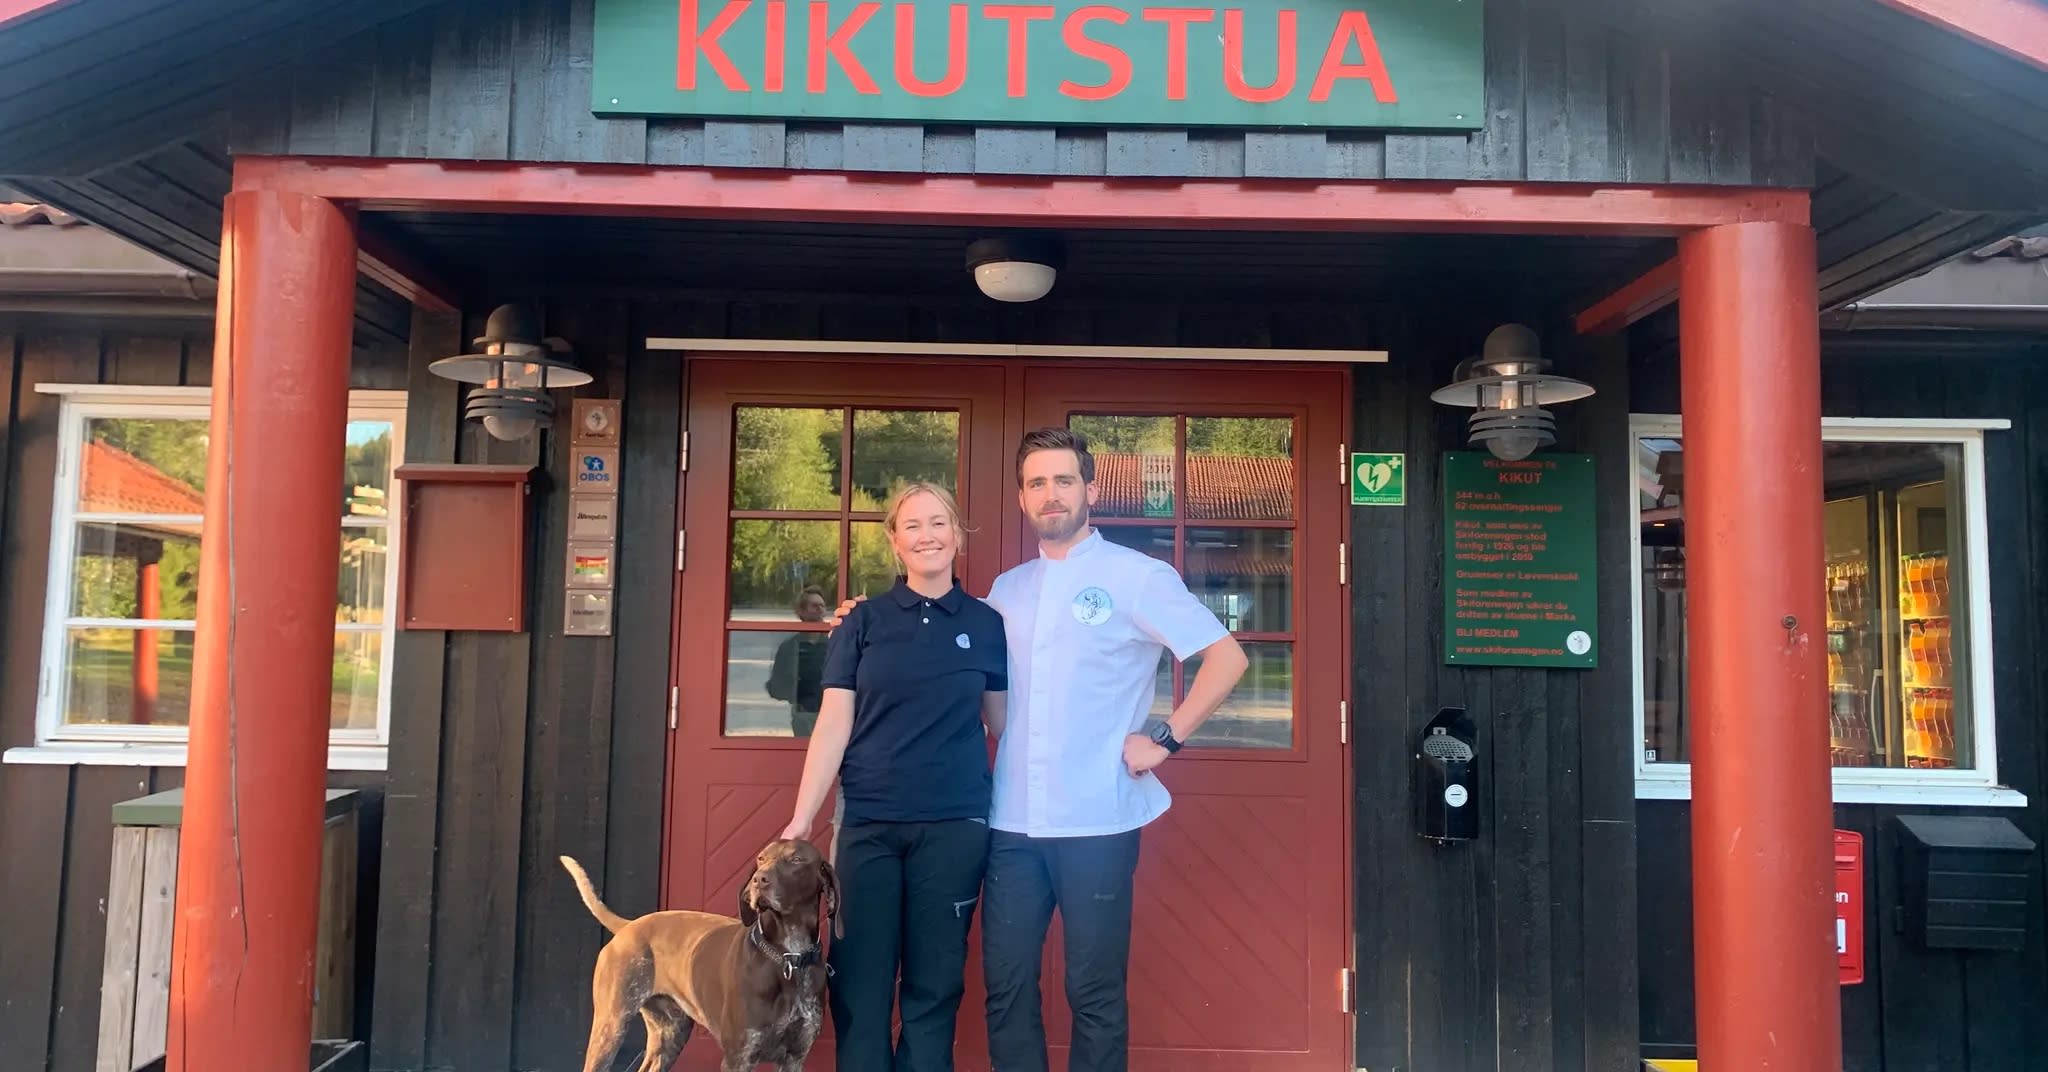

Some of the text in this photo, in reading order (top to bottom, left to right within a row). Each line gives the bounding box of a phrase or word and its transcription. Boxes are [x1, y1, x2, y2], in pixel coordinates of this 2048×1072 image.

[675, 0, 1399, 104] KIKUTSTUA
[1146, 464, 1171, 474] 2019
[580, 473, 609, 481] OBOS
[1498, 472, 1542, 484] KIKUT
[1456, 628, 1519, 638] BLI MEDLEM
